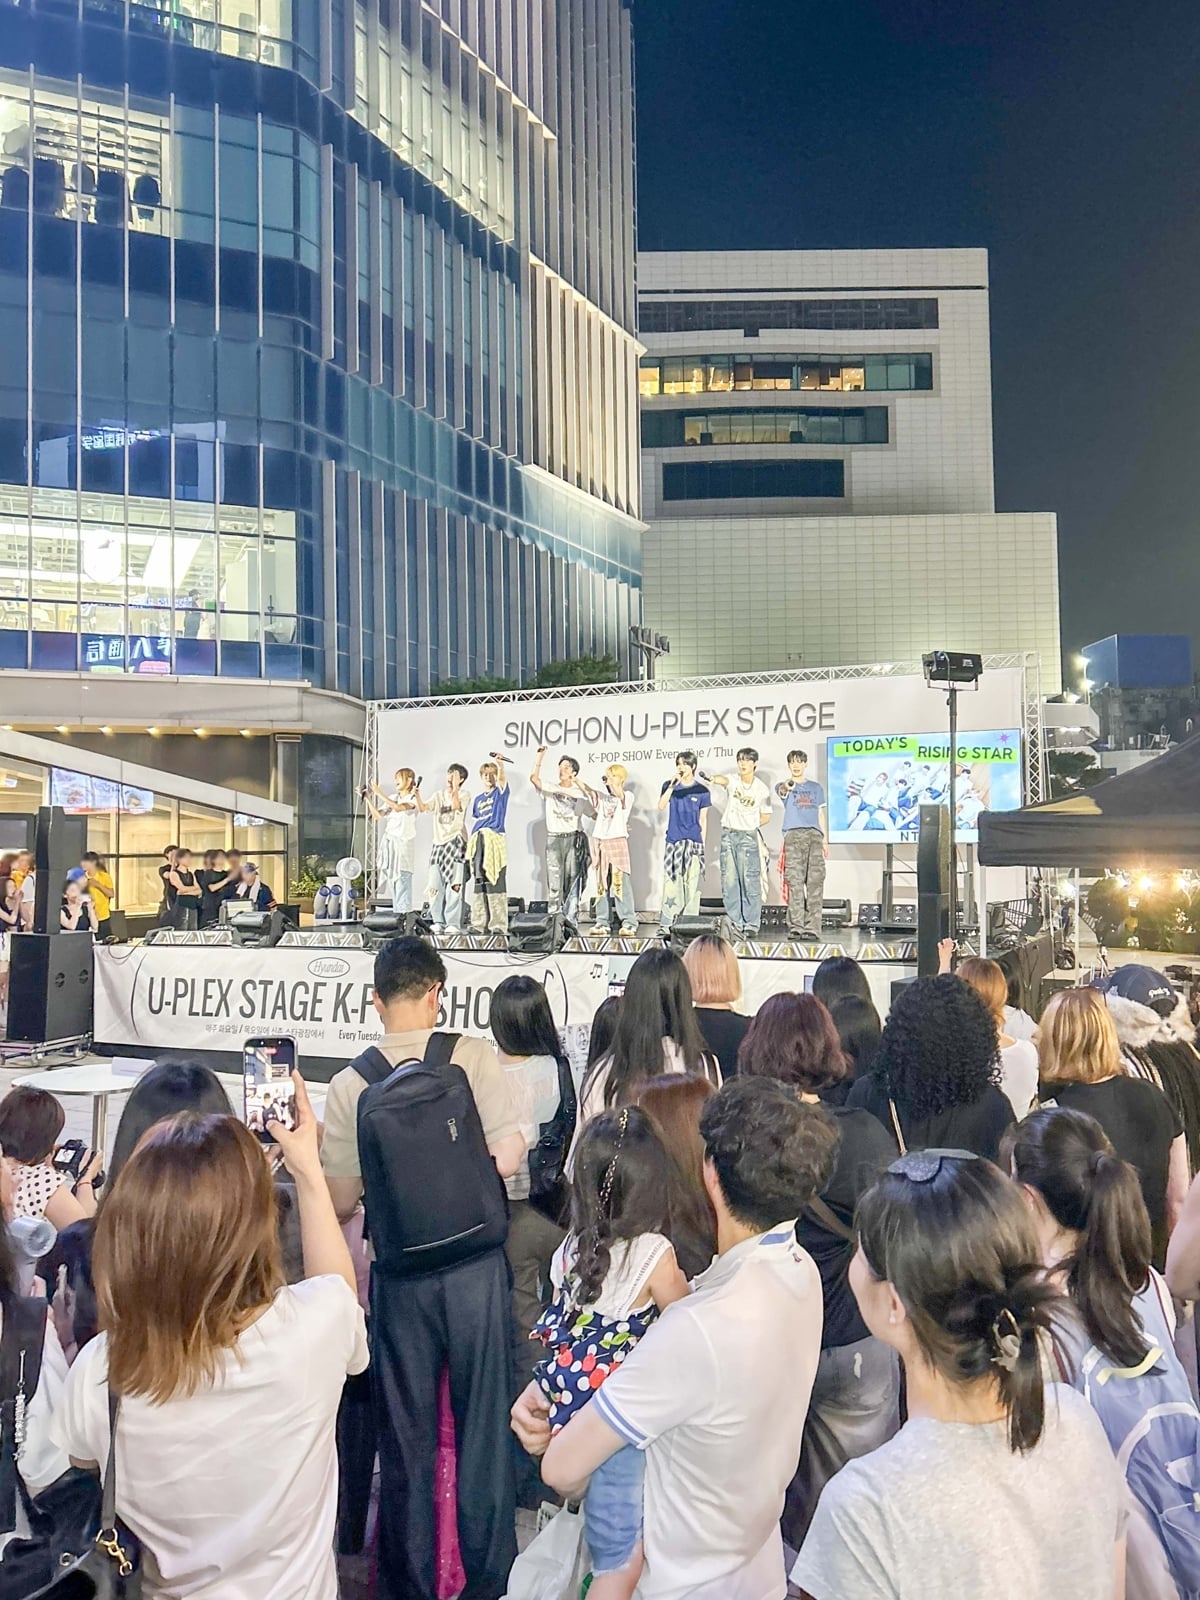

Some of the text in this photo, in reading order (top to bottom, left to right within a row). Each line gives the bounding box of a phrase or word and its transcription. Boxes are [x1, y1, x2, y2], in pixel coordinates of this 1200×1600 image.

[504, 701, 836, 748] SINCHON U-PLEX STAGE
[842, 736, 908, 753] TODAY'S
[971, 746, 1013, 760] STAR
[588, 752, 620, 764] K-POP
[622, 749, 653, 761] SHOW
[656, 748, 680, 760] Ever
[713, 746, 734, 758] Thu
[900, 831, 919, 842] NT
[148, 976, 493, 1029] U-PLEX STAGE K-P SHO
[338, 1029, 382, 1042] Every Tuesda
